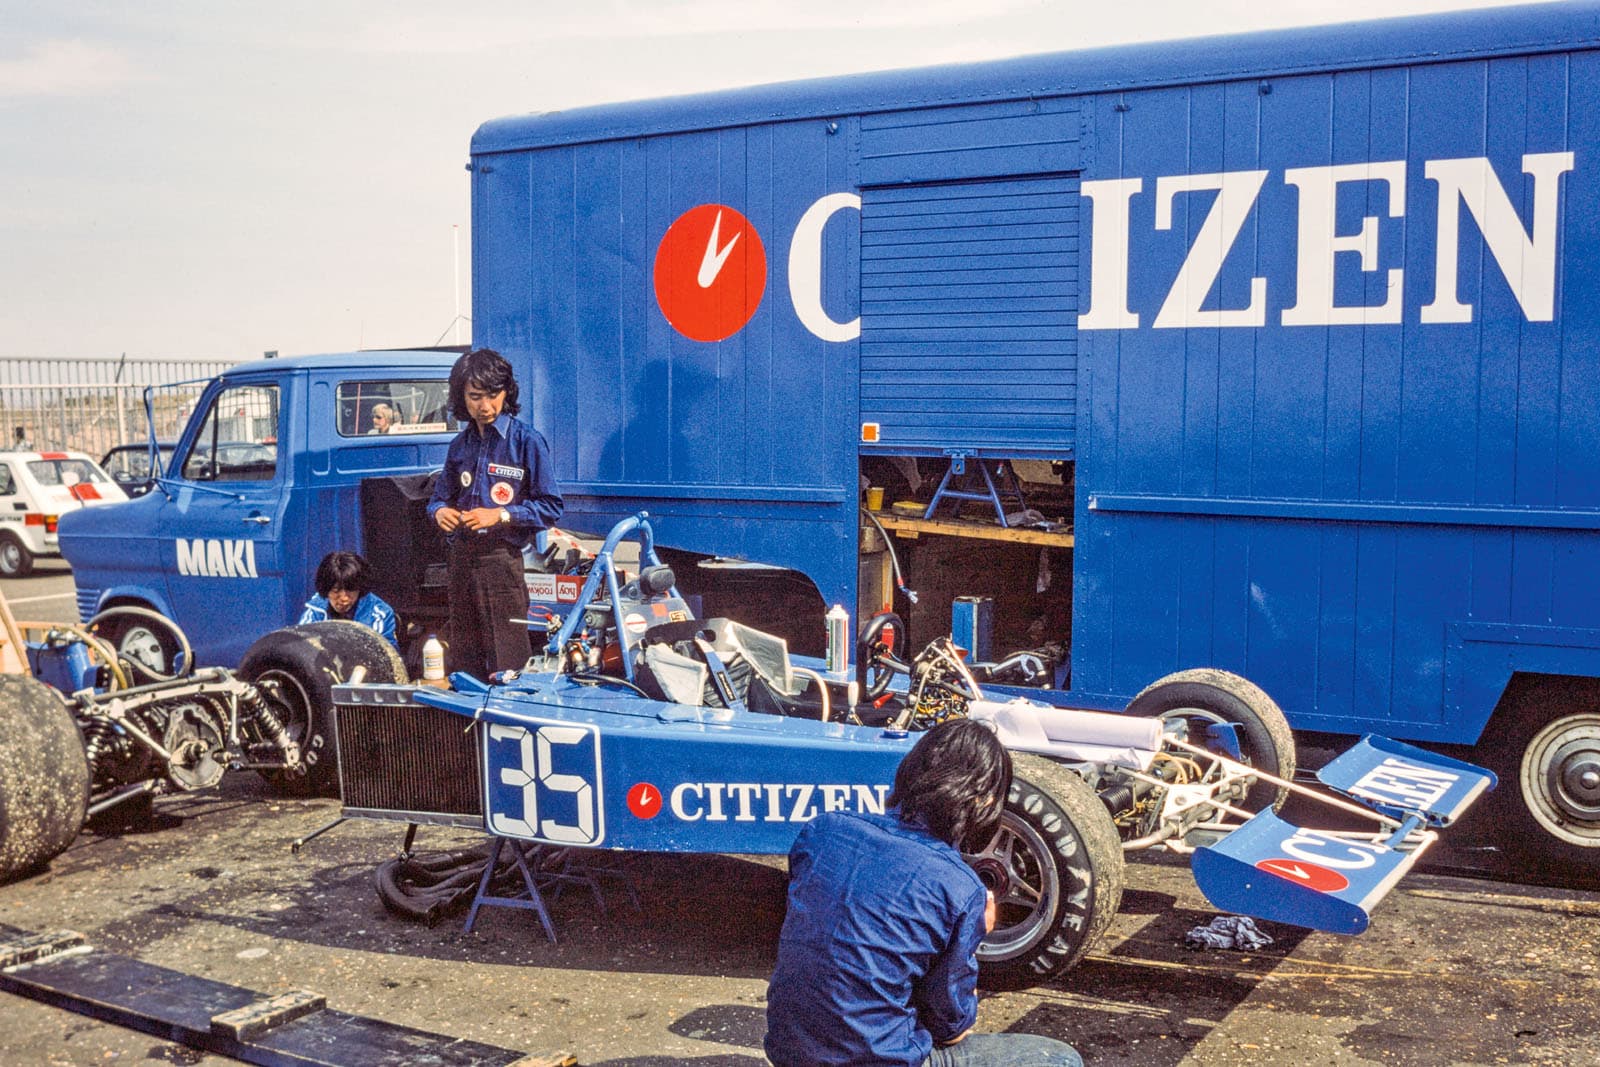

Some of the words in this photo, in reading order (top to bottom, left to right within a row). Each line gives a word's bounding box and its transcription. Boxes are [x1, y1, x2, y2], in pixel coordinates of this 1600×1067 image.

[788, 151, 1575, 342] CIZEN
[176, 538, 258, 578] MAKI
[490, 724, 594, 843] 35
[670, 782, 890, 823] CITIZEN
